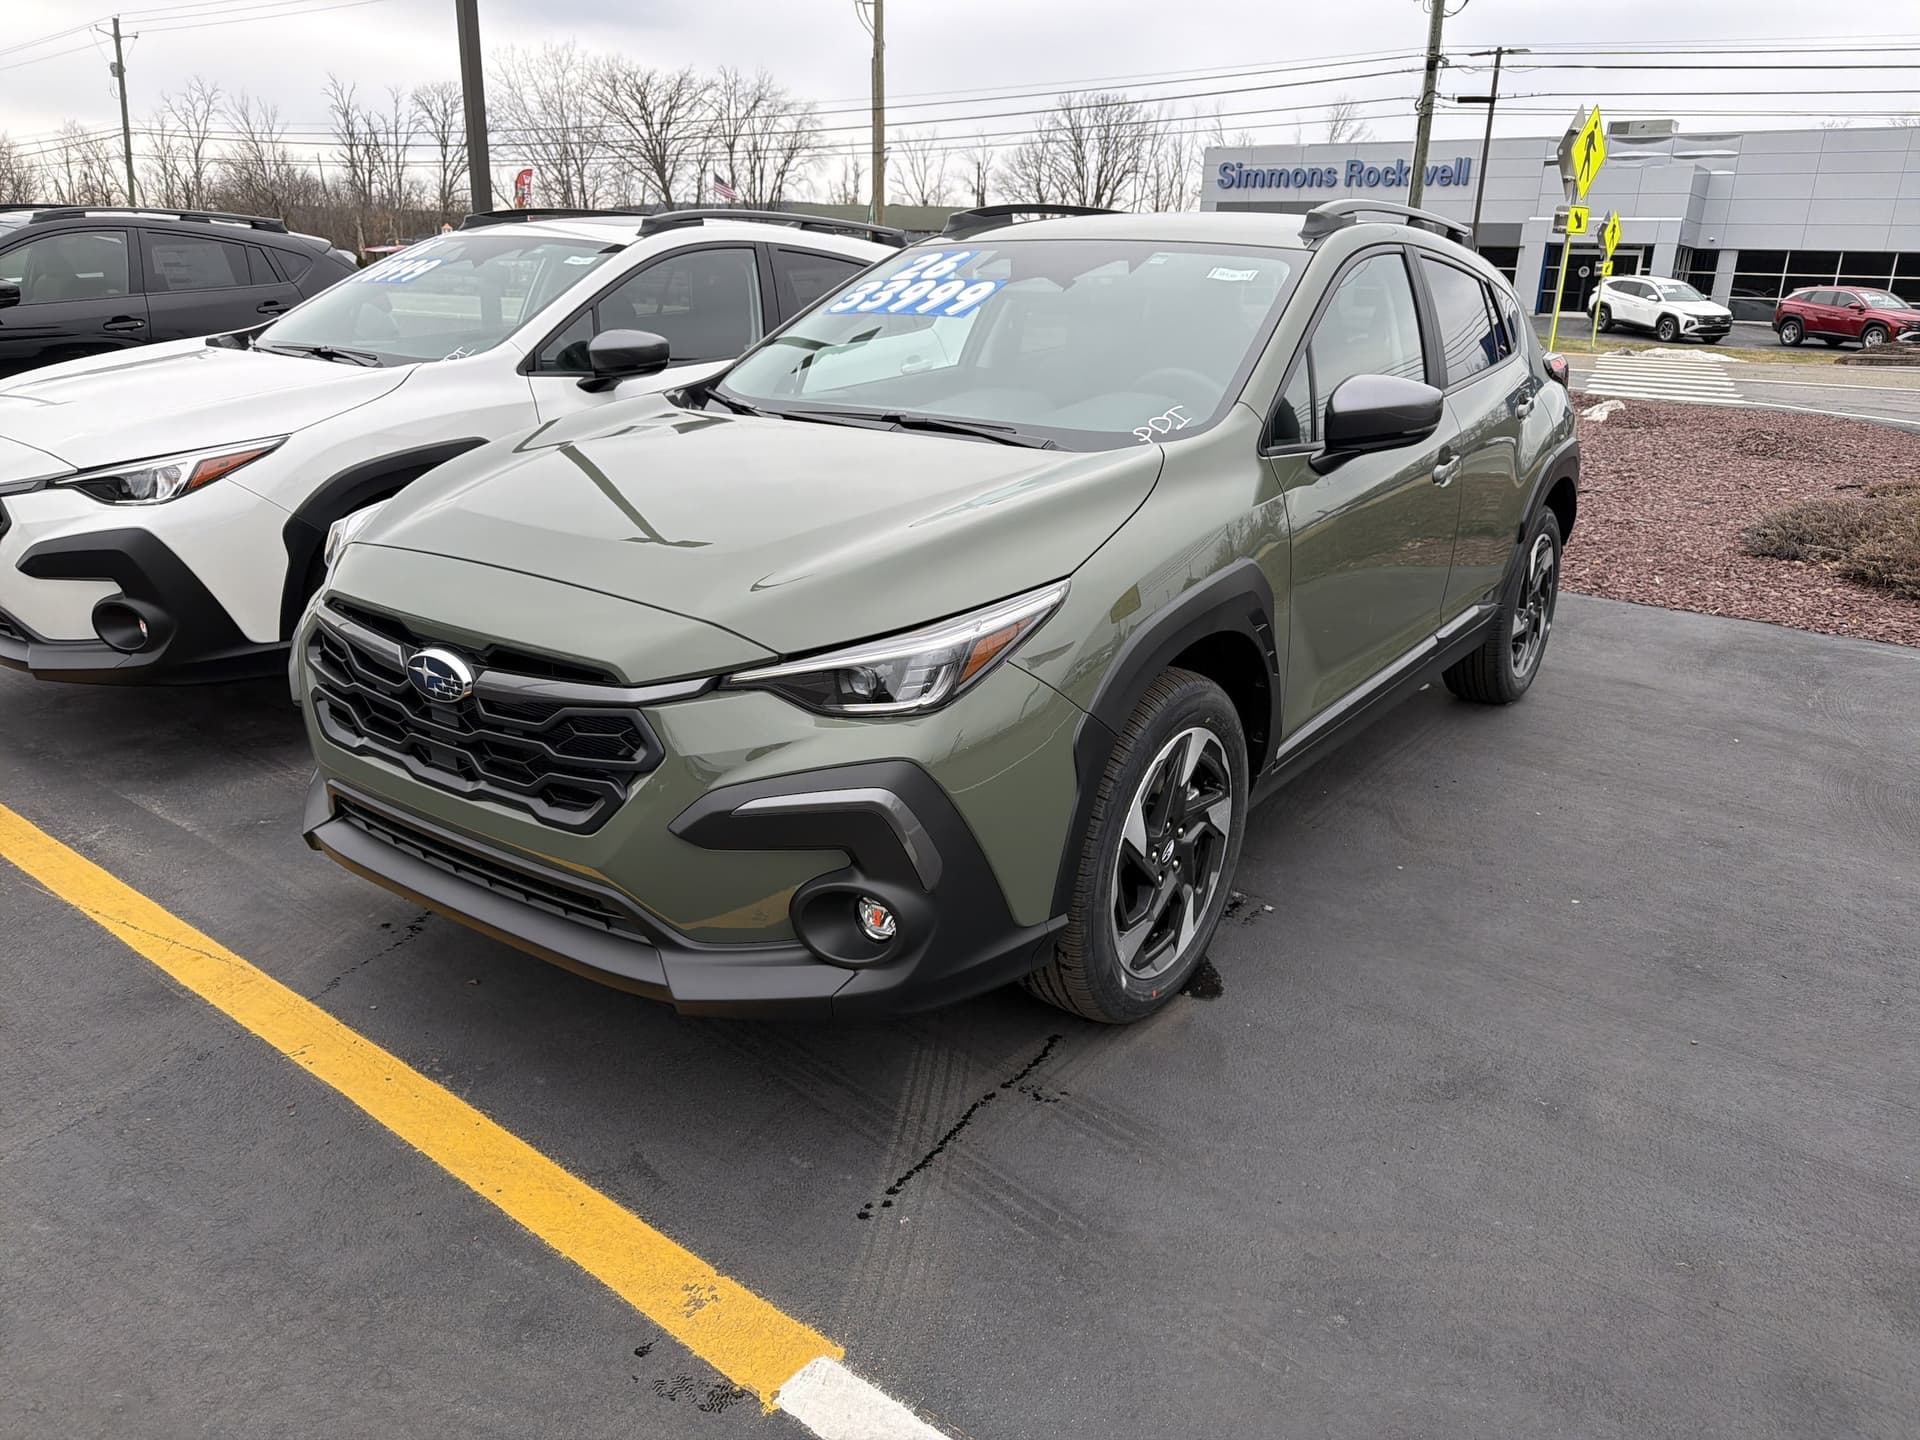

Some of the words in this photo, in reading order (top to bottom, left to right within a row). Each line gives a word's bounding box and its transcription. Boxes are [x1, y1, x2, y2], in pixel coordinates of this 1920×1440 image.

[1217, 161, 1338, 190] Simmons
[890, 251, 971, 281] 26
[830, 279, 996, 316] 33999
[1132, 405, 1193, 444] PDI
